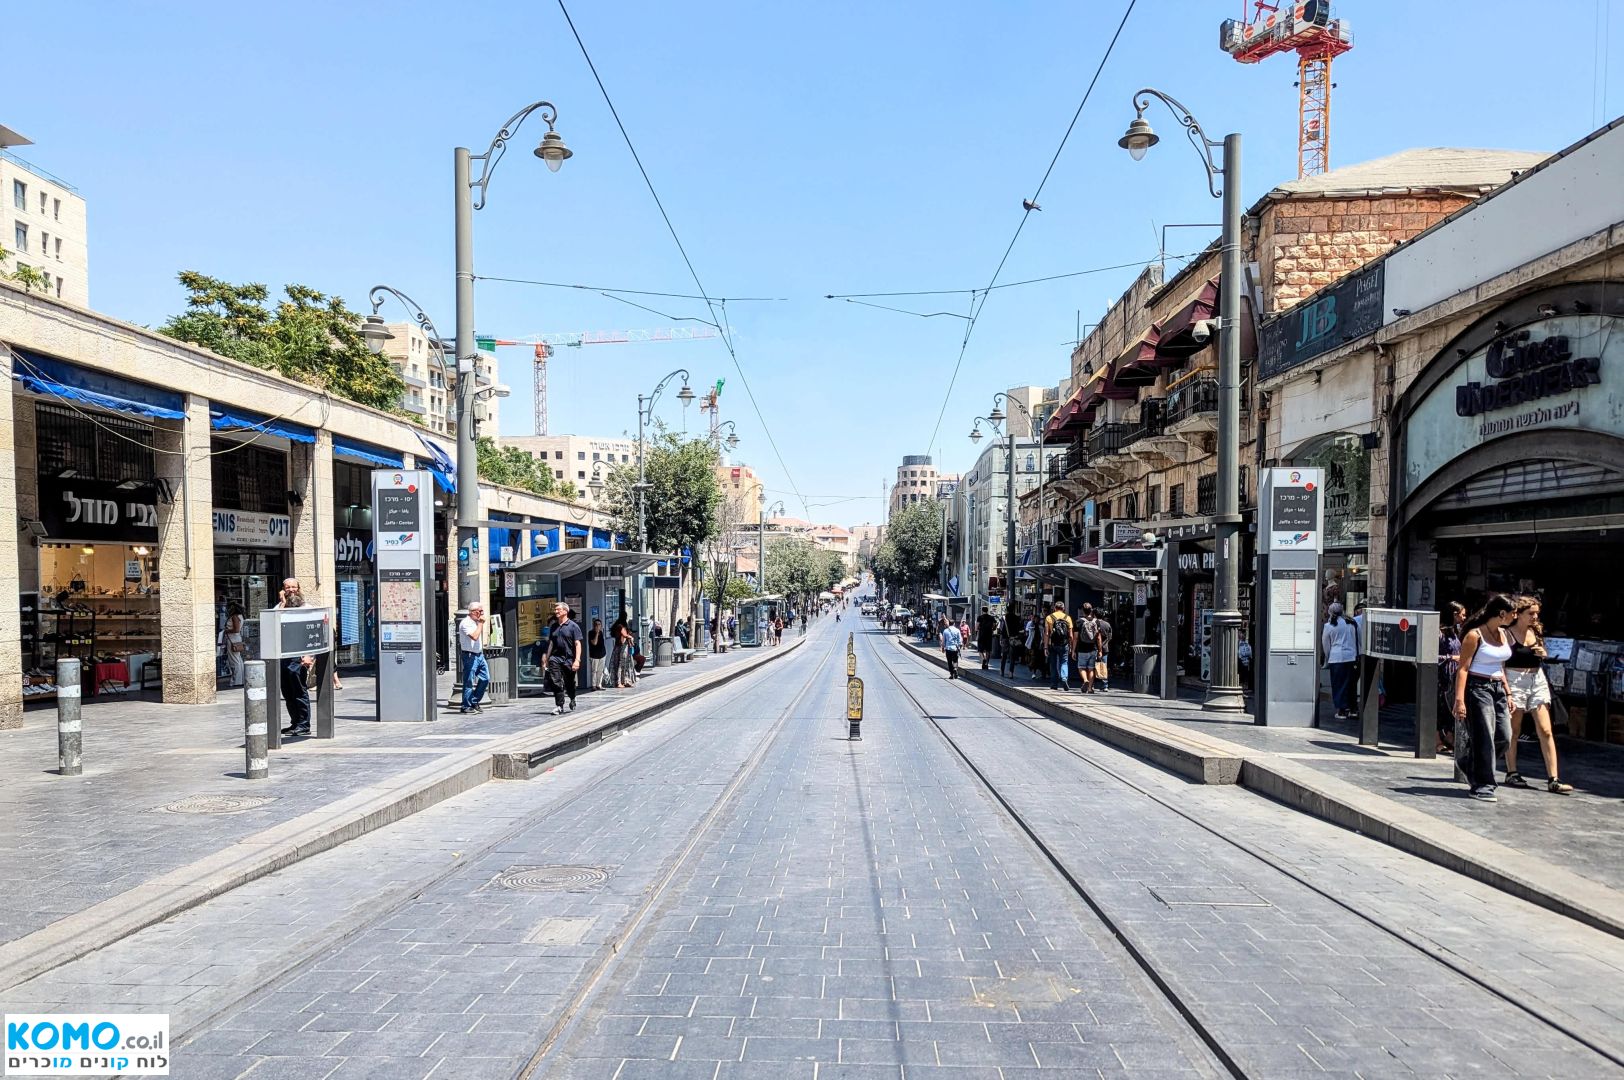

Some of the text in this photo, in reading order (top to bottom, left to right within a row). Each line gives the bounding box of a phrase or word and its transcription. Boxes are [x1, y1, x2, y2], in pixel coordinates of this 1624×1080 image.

[1295, 295, 1337, 348] JB
[1516, 407, 1552, 429] הלבשה
[63, 491, 158, 527] גבי מודל
[269, 517, 290, 536] דניס
